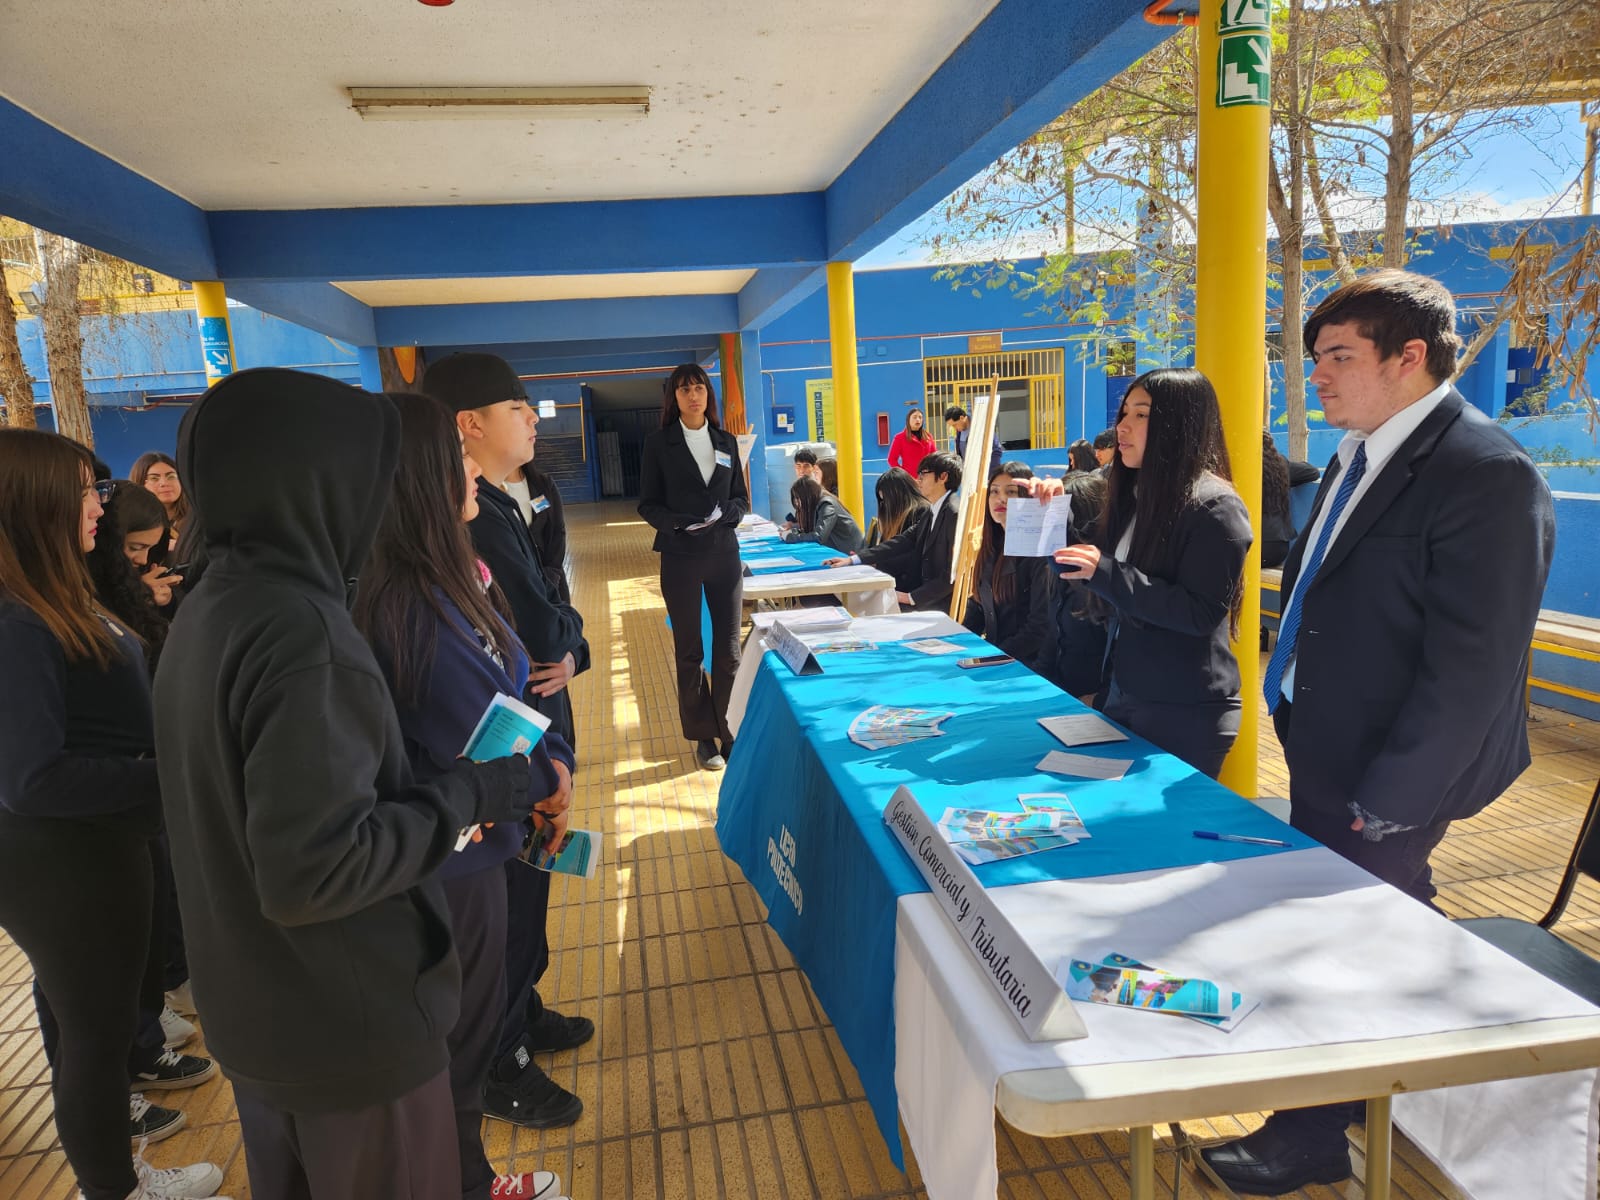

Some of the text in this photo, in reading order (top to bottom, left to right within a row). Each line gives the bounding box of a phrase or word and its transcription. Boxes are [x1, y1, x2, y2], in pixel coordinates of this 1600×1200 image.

[891, 801, 1032, 1019] Gestión Comercial y Tributaria
